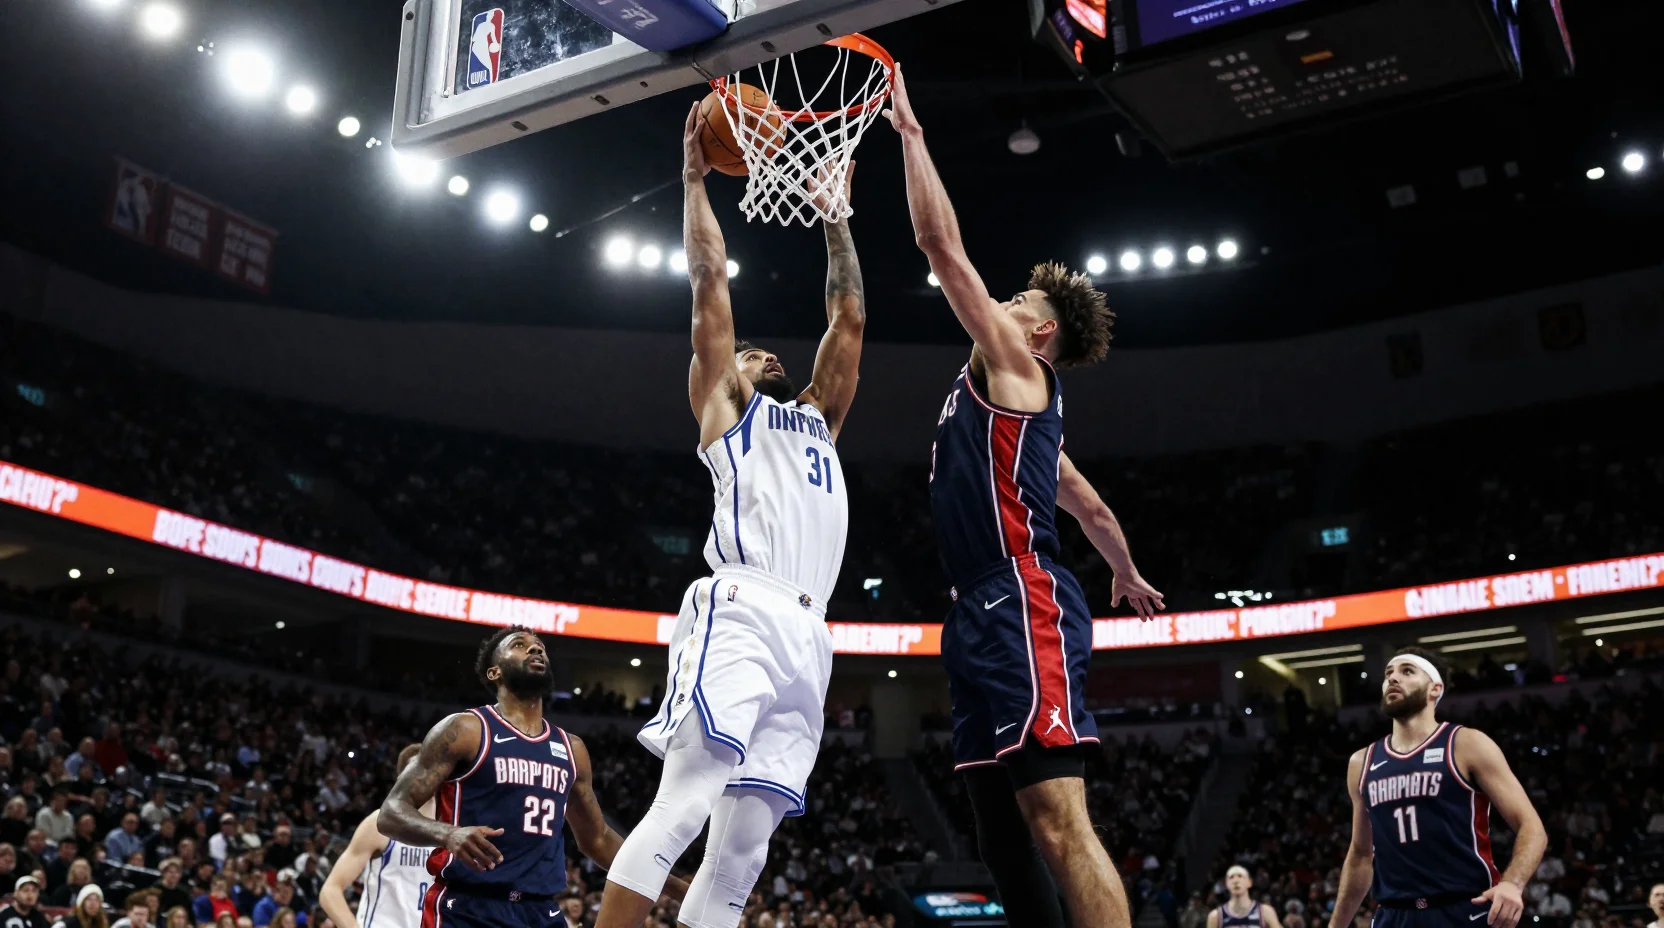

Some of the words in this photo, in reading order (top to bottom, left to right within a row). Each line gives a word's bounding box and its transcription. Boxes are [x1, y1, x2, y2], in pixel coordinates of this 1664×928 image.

[805, 446, 833, 494] 31
[522, 795, 556, 836] 22
[1393, 805, 1419, 844] 11
